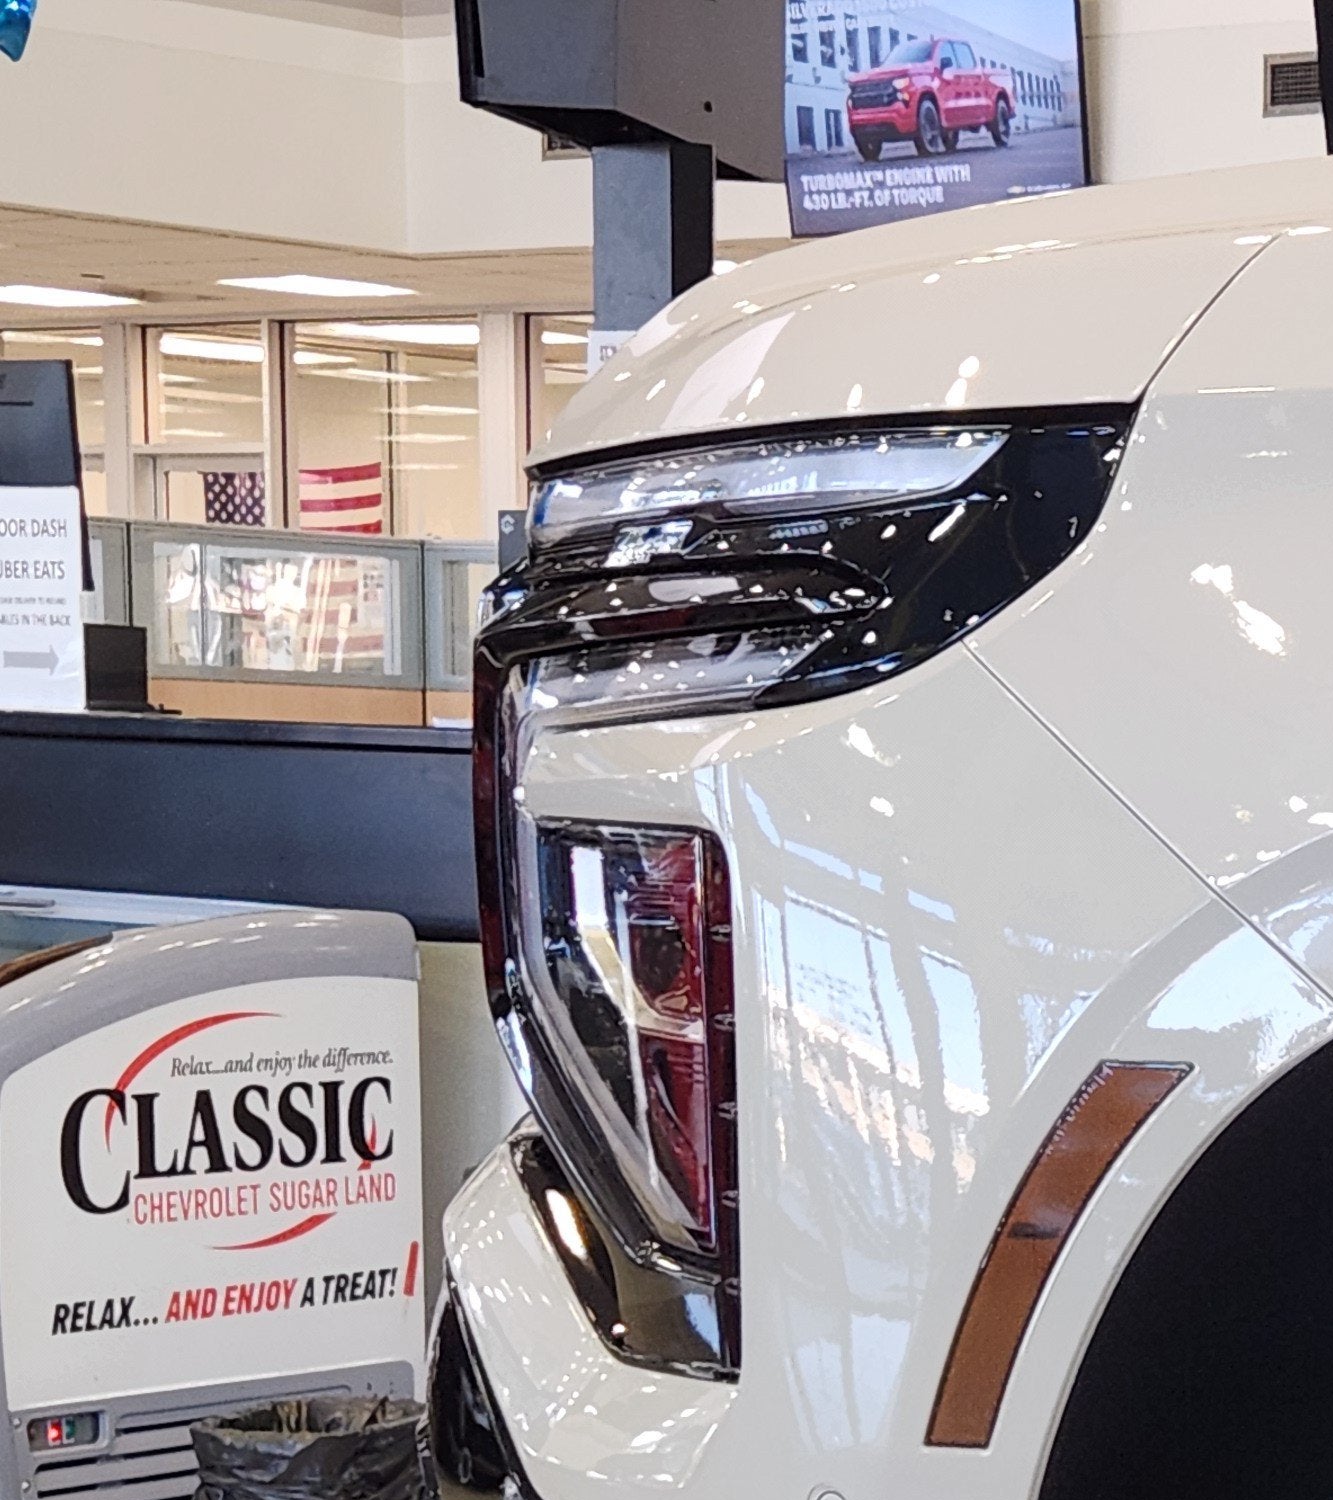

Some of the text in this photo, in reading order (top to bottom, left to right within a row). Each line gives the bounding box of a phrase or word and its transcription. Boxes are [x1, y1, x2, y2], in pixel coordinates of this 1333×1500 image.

[935, 163, 971, 183] WITH
[874, 188, 890, 207] OF
[892, 185, 944, 207] TORQUE
[31, 518, 67, 537] DASH
[33, 560, 65, 579] EATS
[256, 1050, 295, 1077] enjoy
[297, 1049, 317, 1069] the
[322, 1047, 393, 1073] difference.
[60, 1076, 394, 1214] CLASSIC
[134, 1172, 396, 1225] CHEVROLET SUGAR LAND
[52, 1267, 398, 1336] RELAX... AND ENJOY A TREAT!
